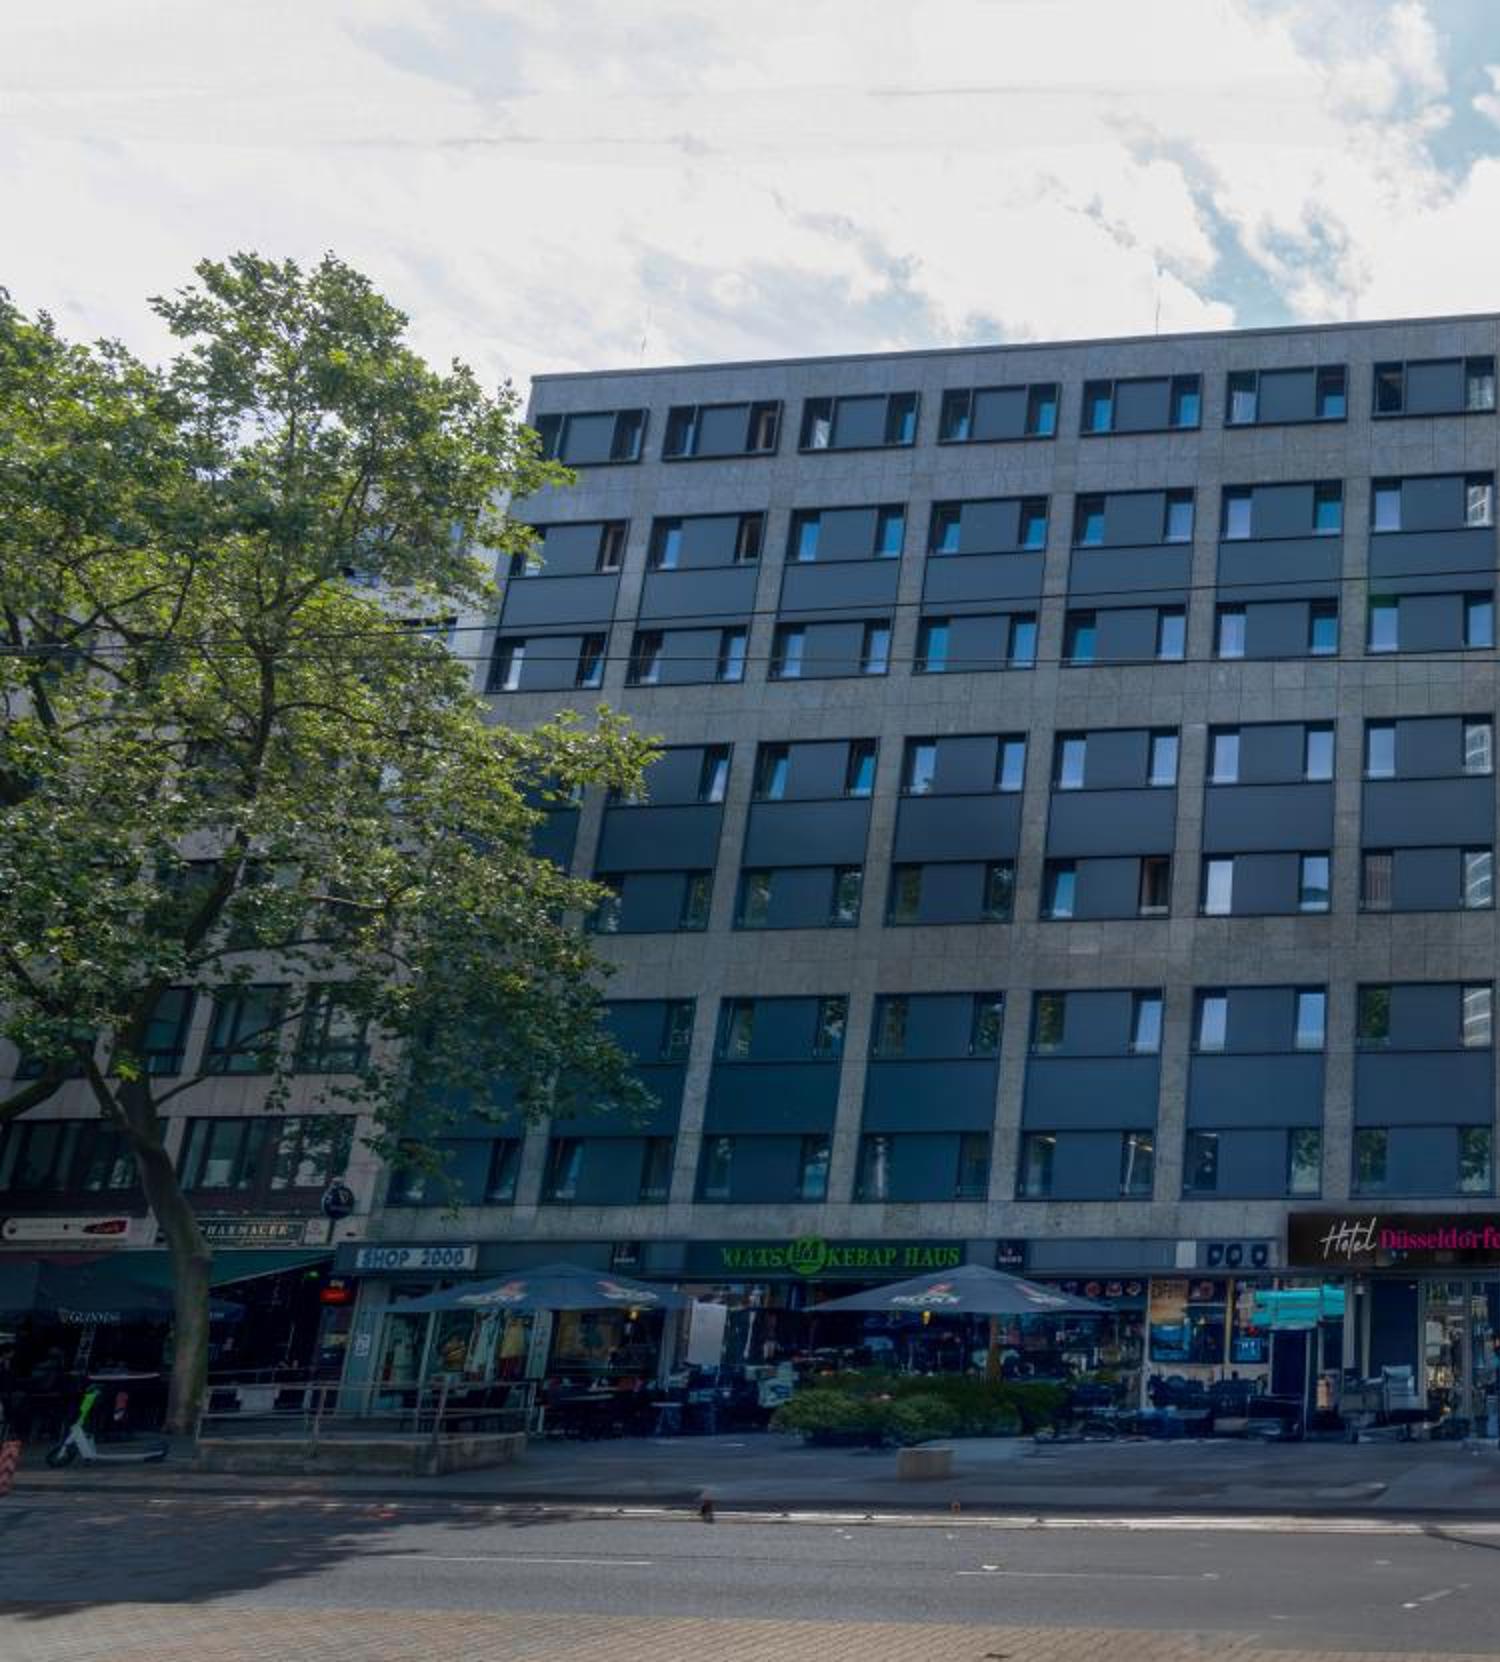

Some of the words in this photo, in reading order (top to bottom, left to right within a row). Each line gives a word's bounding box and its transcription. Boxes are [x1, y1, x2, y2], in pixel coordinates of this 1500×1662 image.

[1319, 1217, 1377, 1260] Hotel
[362, 1250, 410, 1266] SHOP
[421, 1250, 465, 1266] 2000
[827, 1247, 897, 1267] KEBAP
[904, 1247, 961, 1267] HAUS
